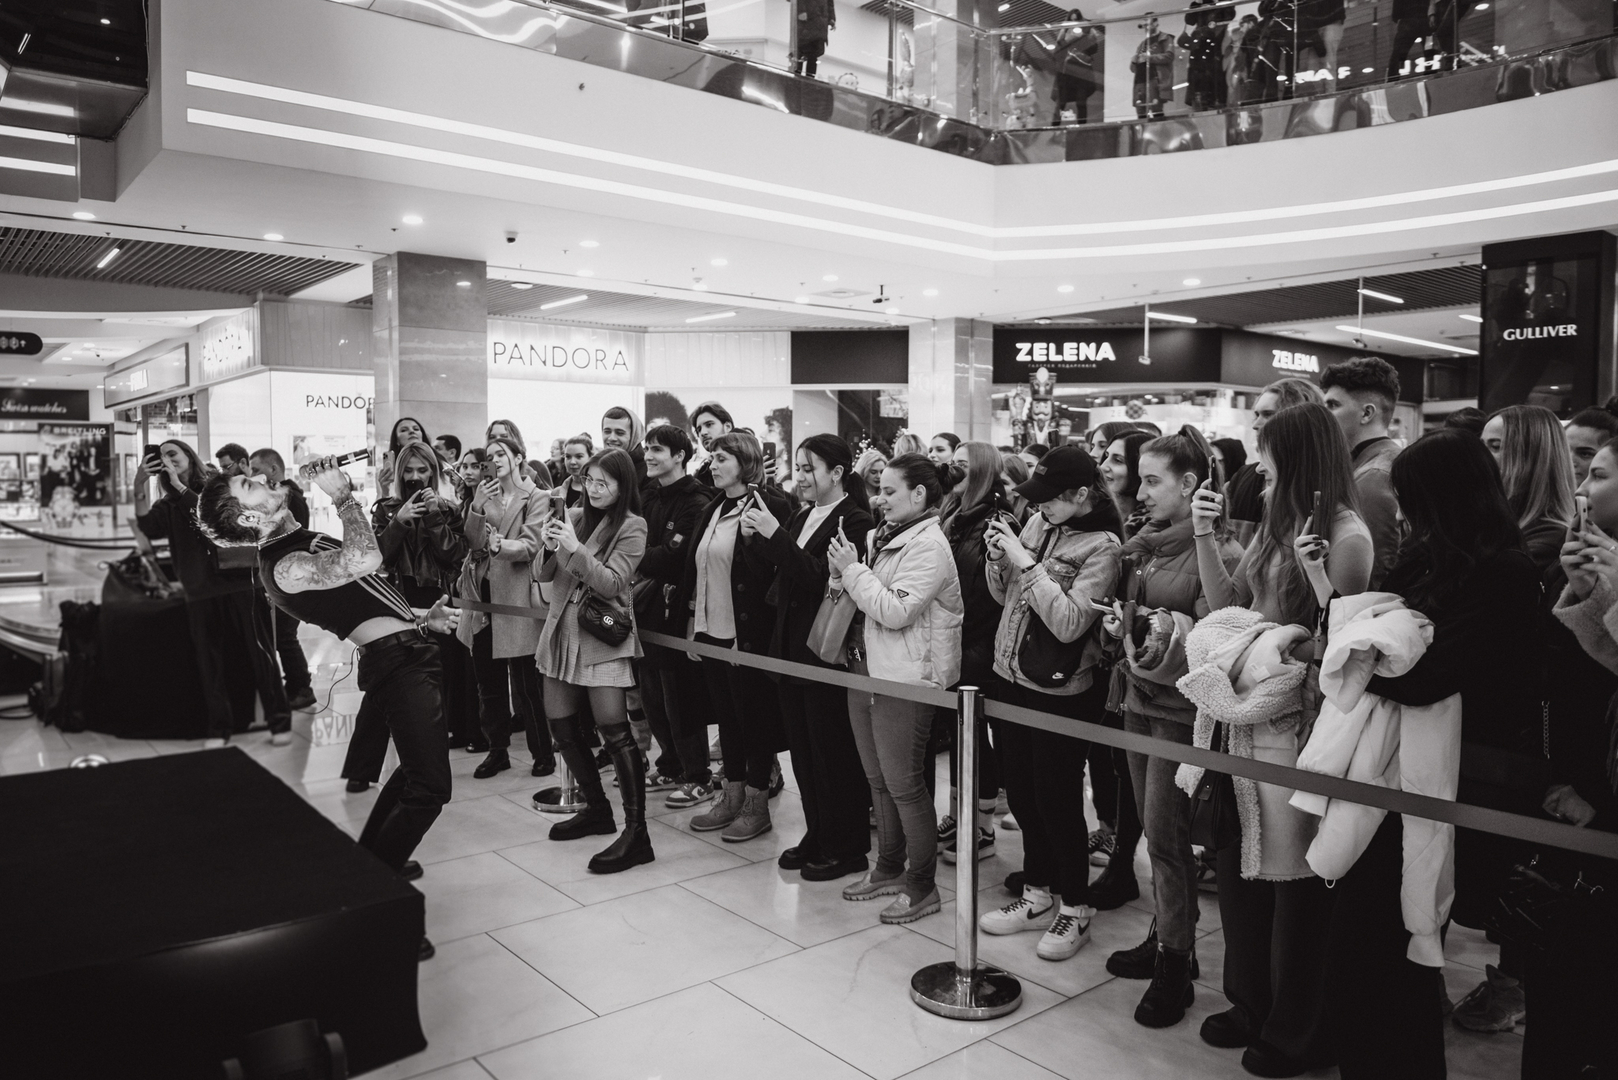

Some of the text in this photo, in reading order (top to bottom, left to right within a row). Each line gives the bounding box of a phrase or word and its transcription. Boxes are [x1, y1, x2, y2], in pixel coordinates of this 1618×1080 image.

[1503, 324, 1578, 341] GULLIVER
[493, 341, 629, 371] PANDORA
[1015, 342, 1116, 361] ZELENA
[1272, 349, 1320, 373] ZELENA
[306, 394, 375, 409] PANDOR
[53, 426, 107, 435] BREITLING
